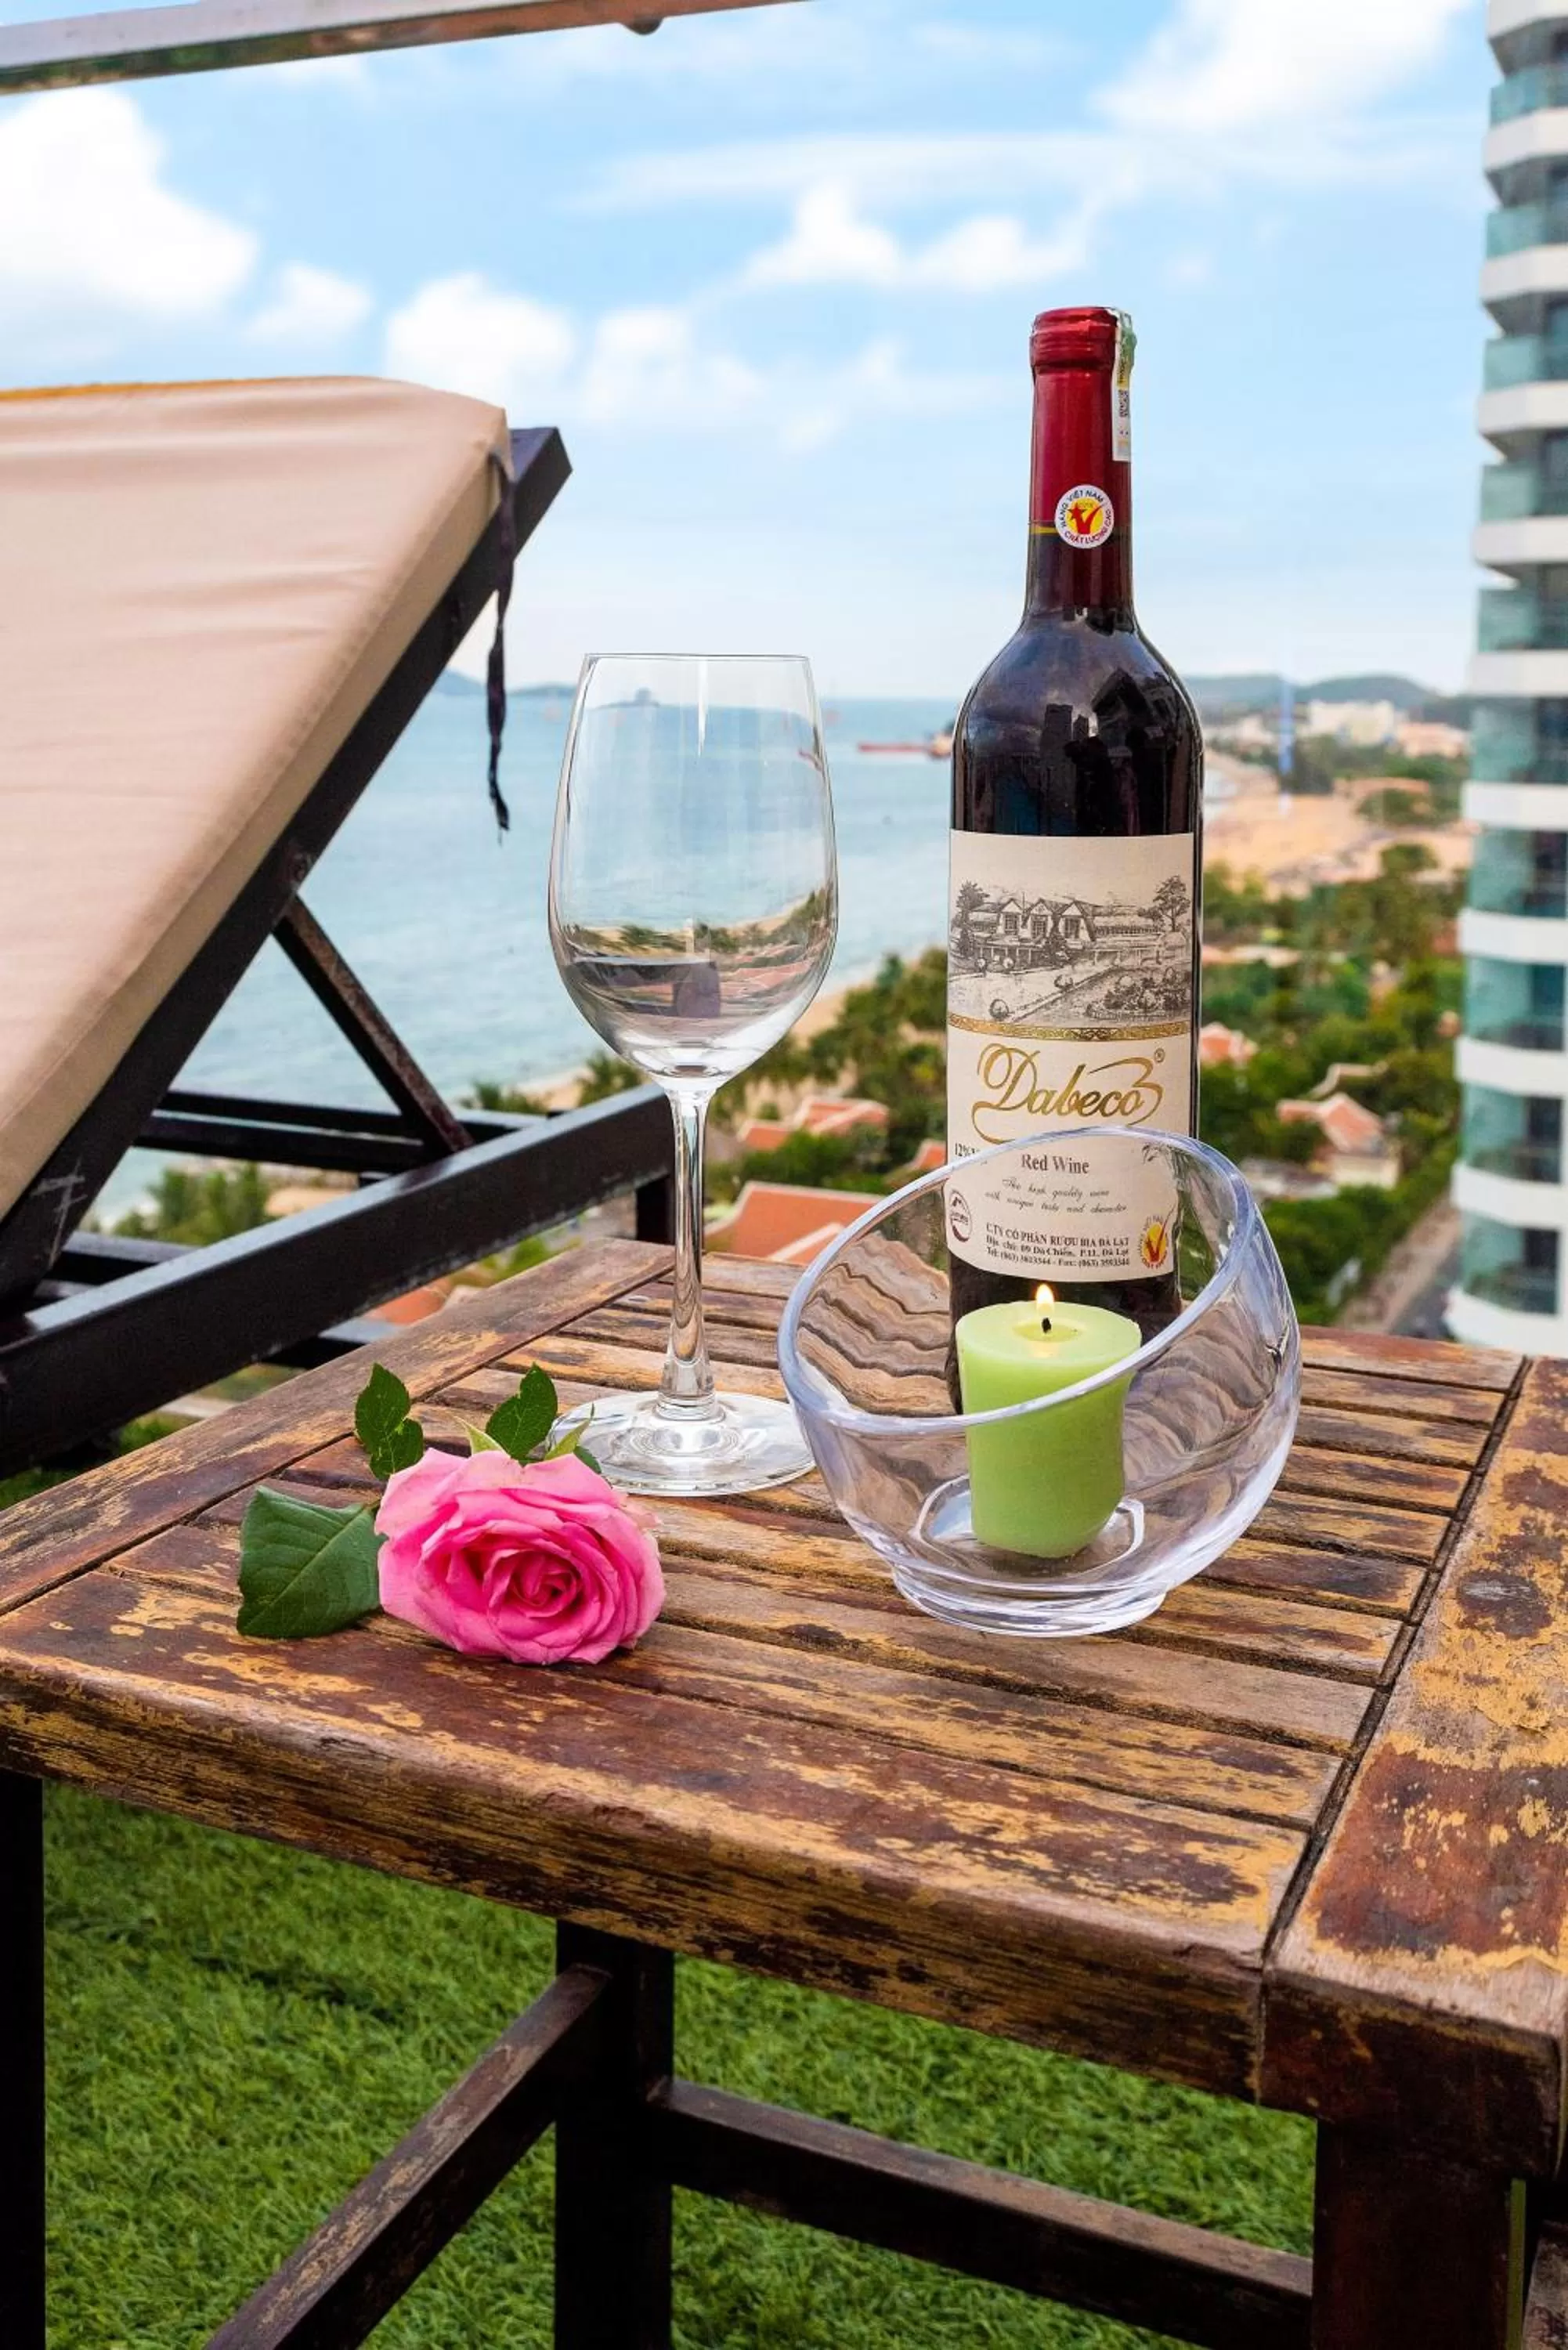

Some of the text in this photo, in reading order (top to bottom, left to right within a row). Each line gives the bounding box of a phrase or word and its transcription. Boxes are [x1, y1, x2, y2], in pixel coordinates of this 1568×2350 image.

[1086, 490, 1104, 502] NAM
[972, 1043, 1163, 1144] Dabeco
[1021, 1154, 1090, 1173] Red Wine
[1052, 1185, 1083, 1202] quality
[1066, 1203, 1086, 1213] and
[1080, 1238, 1097, 1247] BIA
